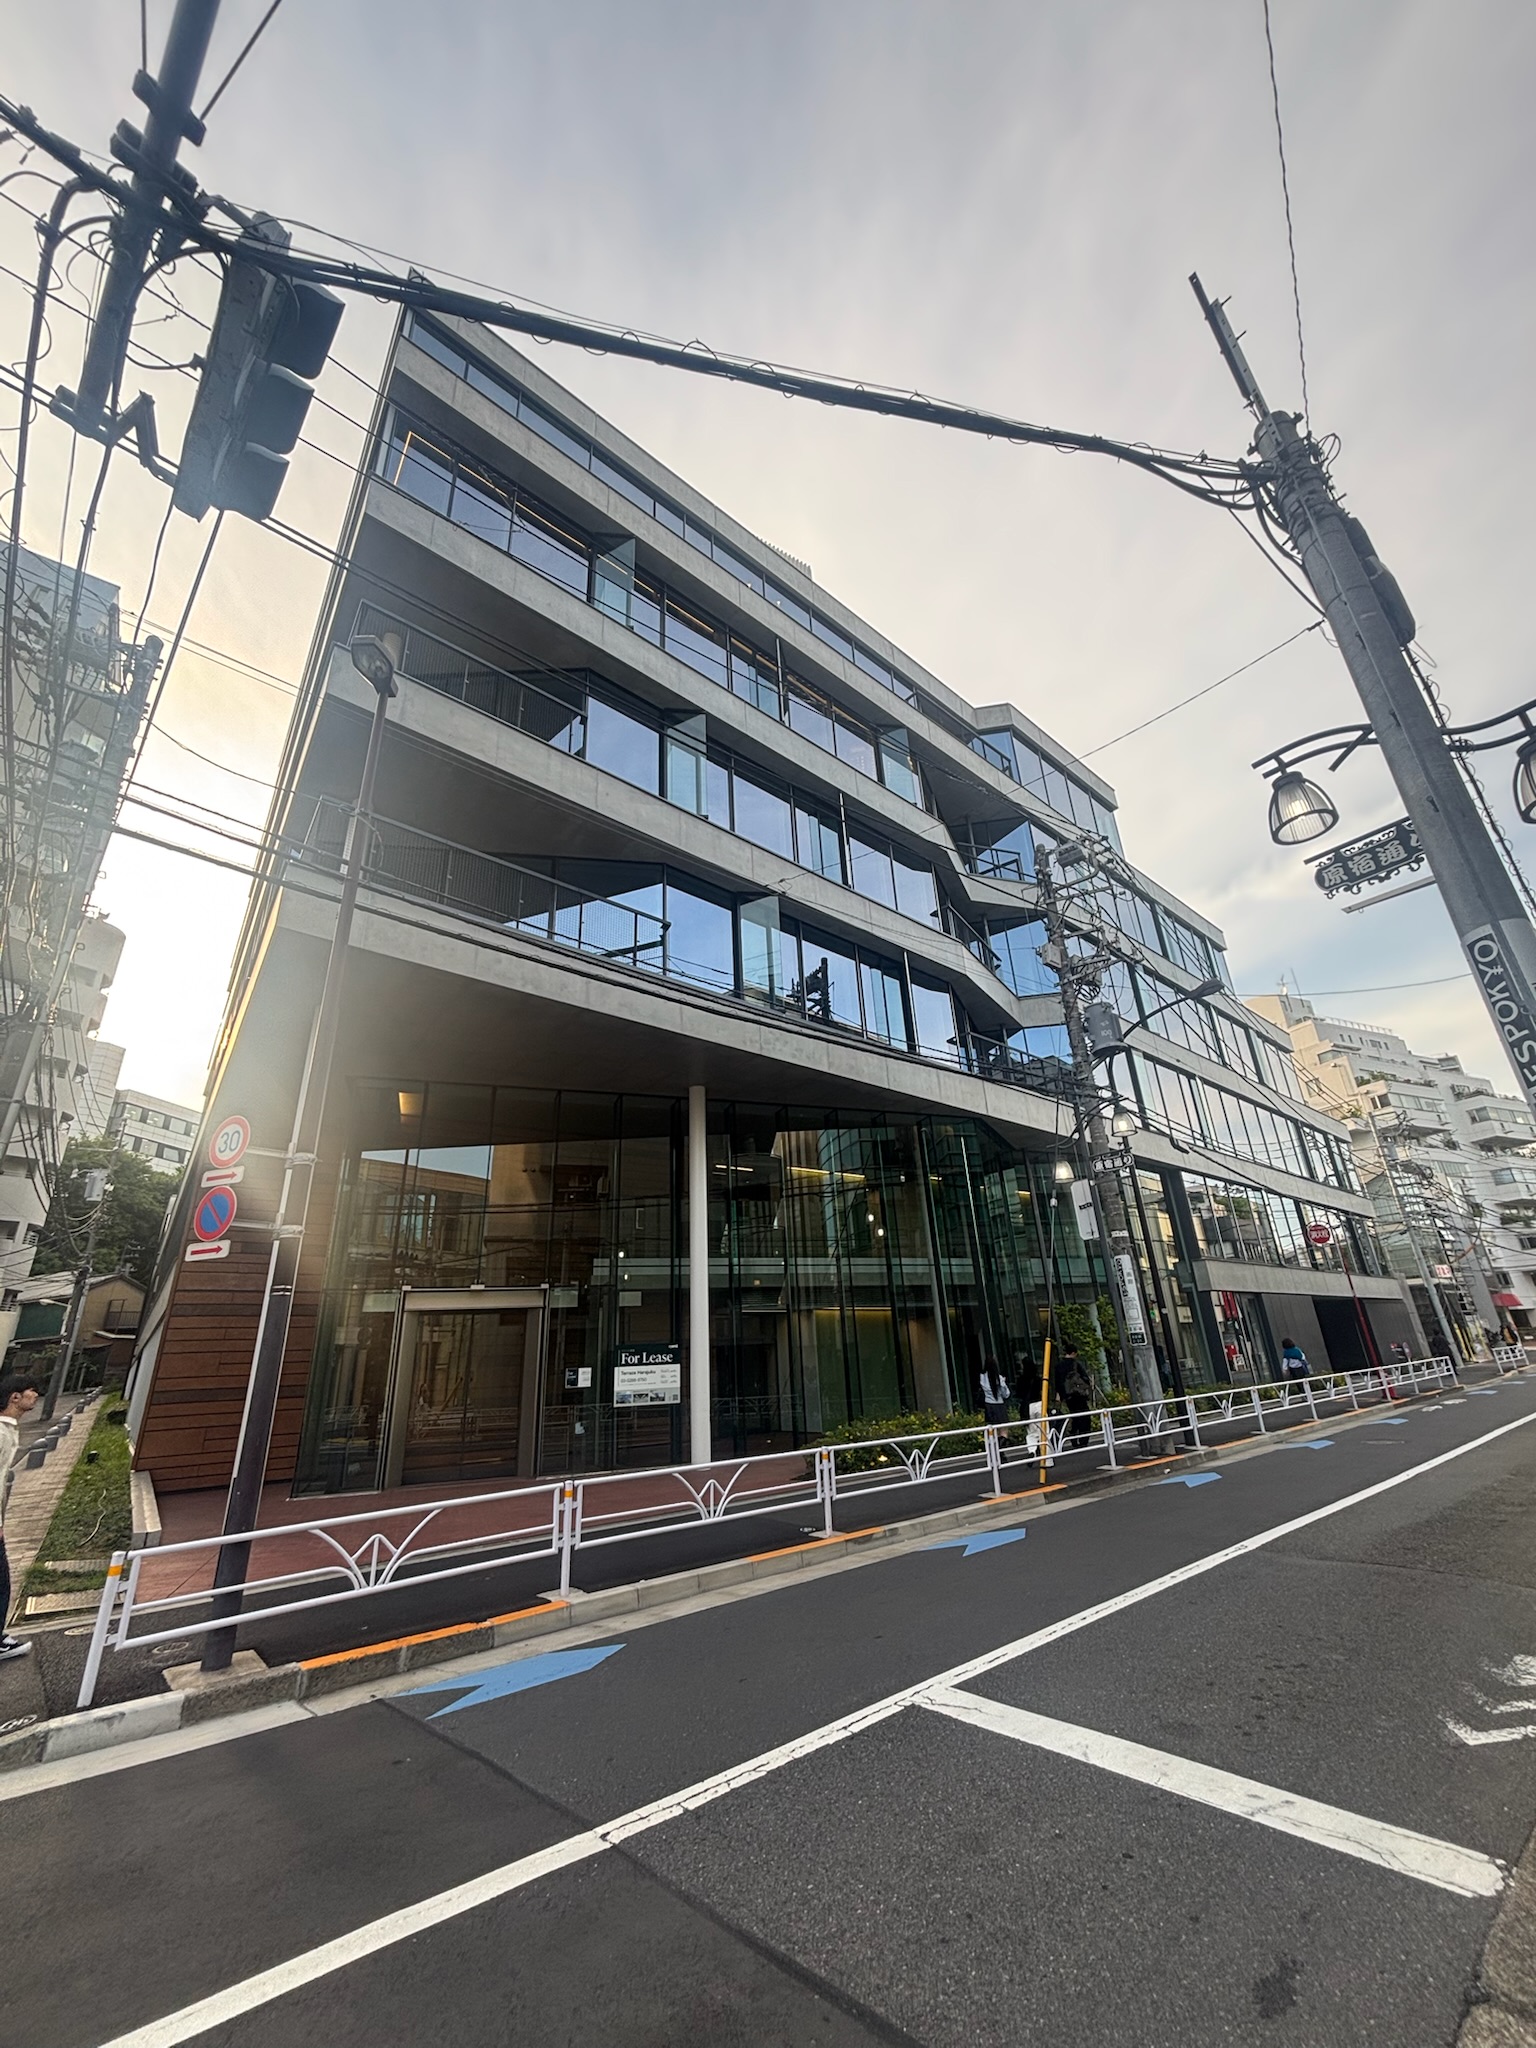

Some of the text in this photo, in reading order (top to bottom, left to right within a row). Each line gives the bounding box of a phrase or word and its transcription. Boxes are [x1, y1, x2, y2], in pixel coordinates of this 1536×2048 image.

[218, 1130, 241, 1153] 30
[621, 1351, 673, 1365] For Lease
